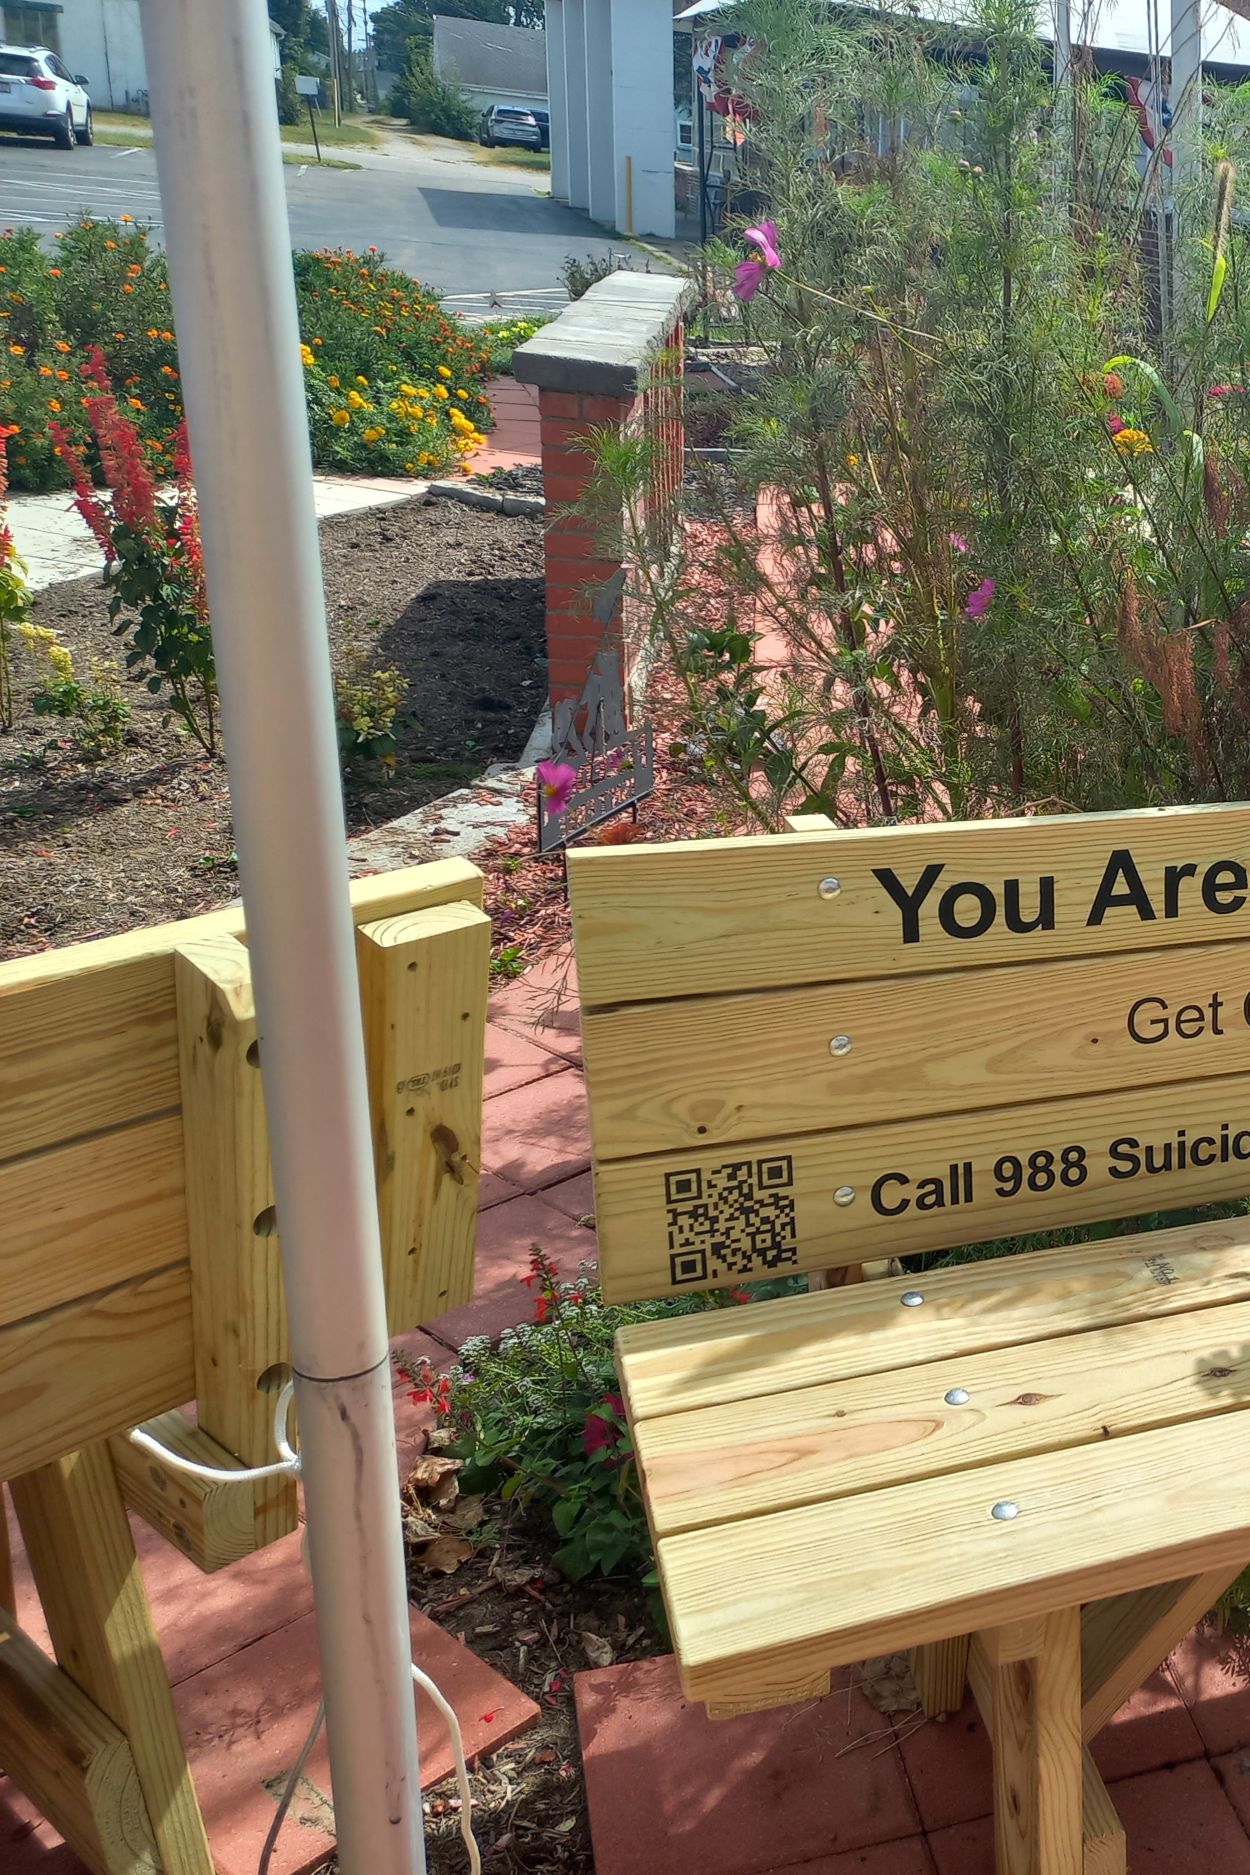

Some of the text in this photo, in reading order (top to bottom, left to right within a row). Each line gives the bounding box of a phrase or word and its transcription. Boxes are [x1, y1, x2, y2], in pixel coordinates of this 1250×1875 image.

[871, 864, 1055, 944] You
[1086, 849, 1249, 926] Are
[1128, 992, 1224, 1044] Get
[871, 1162, 974, 1216] Call
[993, 1146, 1088, 1198] 988
